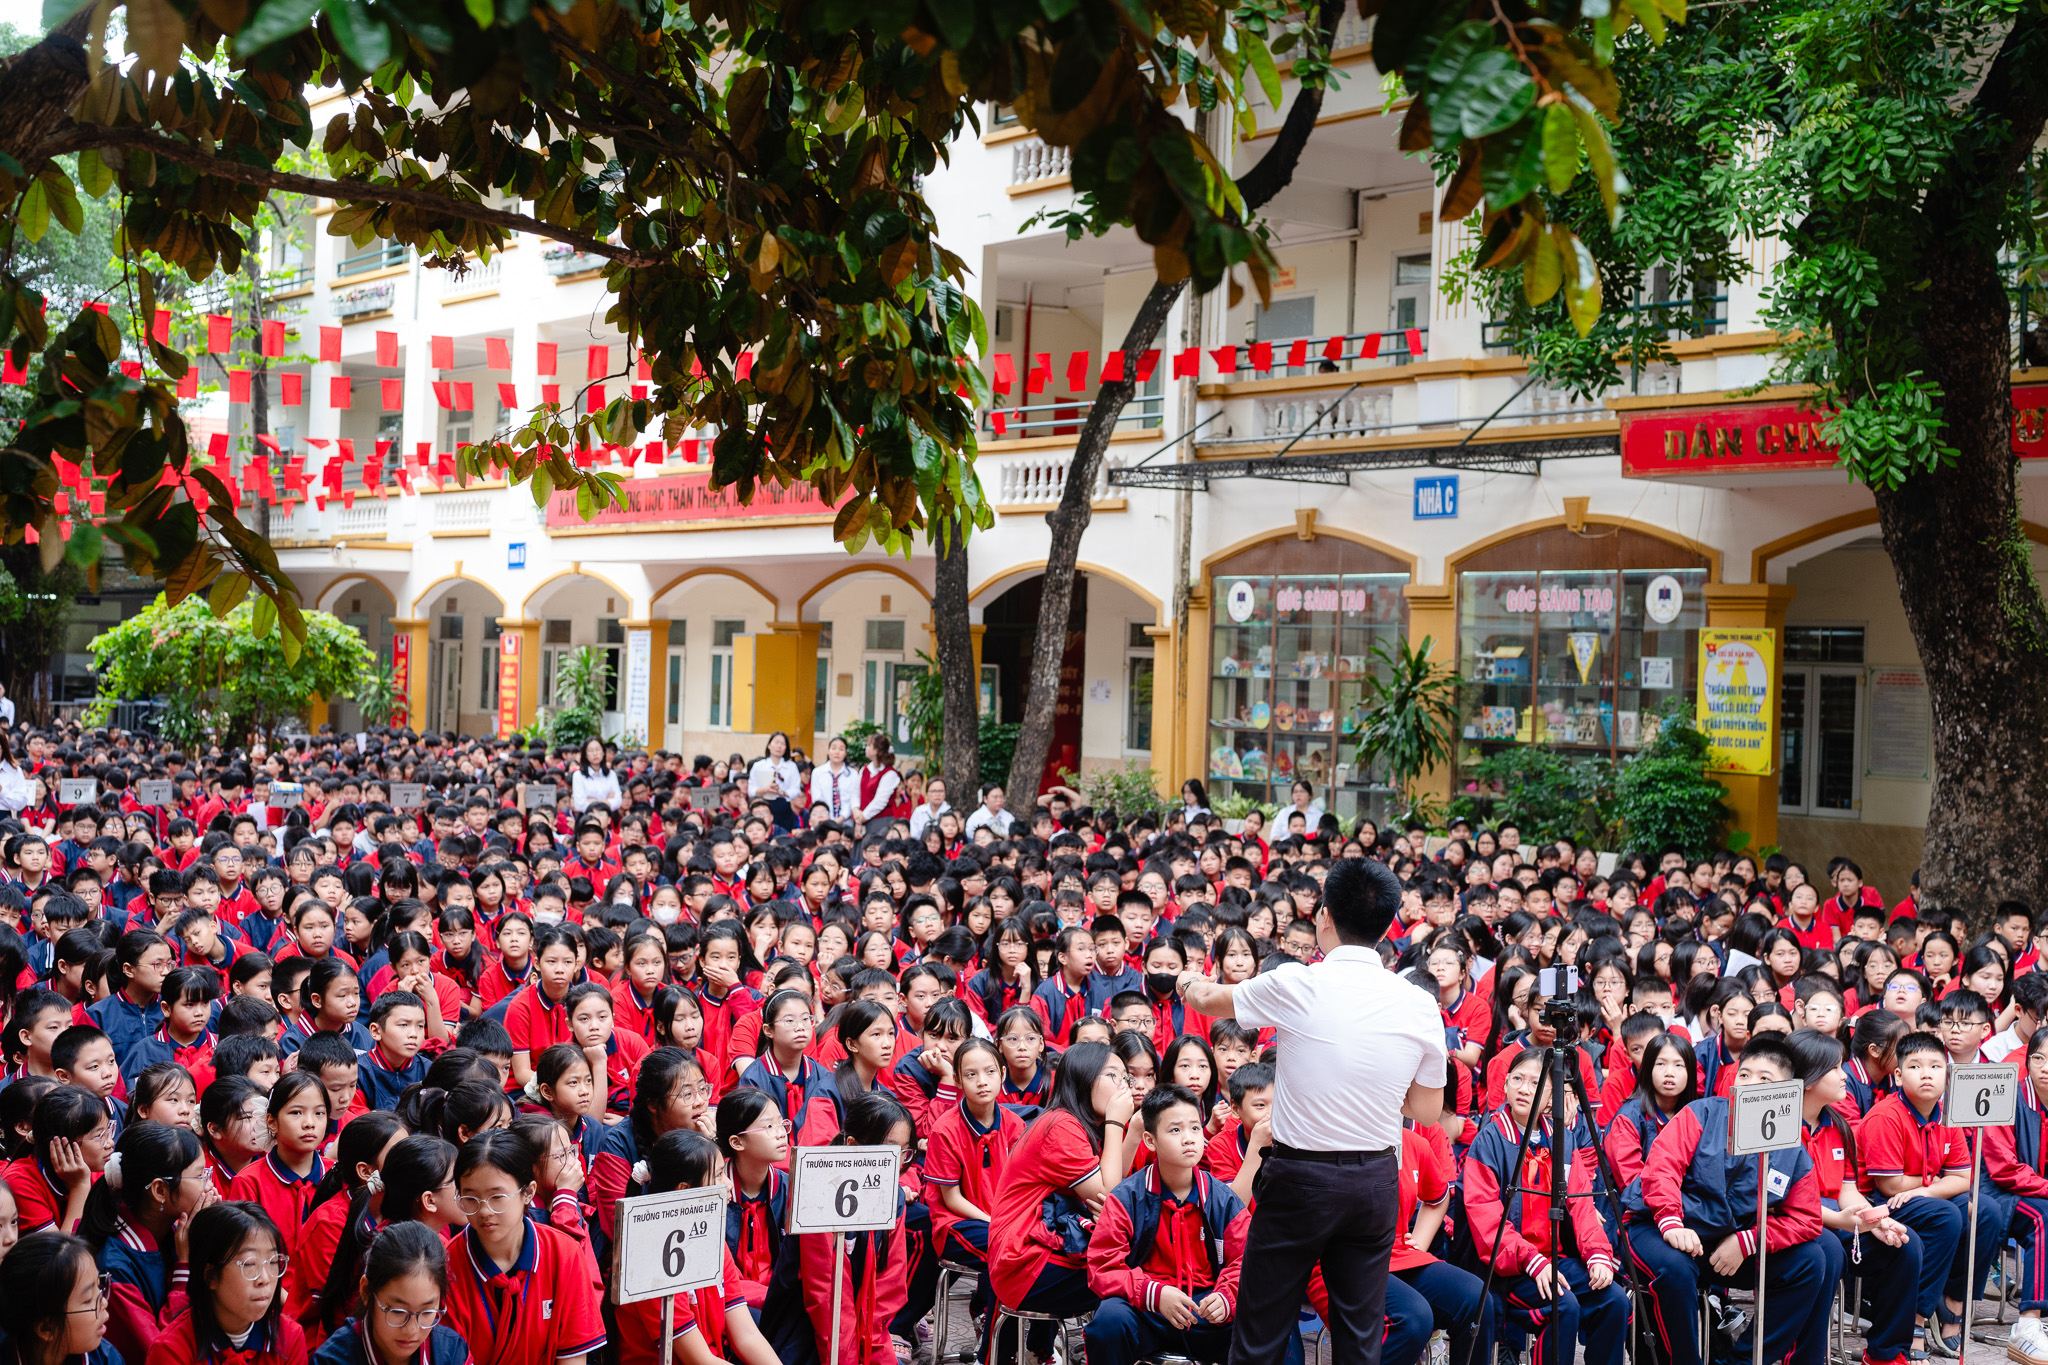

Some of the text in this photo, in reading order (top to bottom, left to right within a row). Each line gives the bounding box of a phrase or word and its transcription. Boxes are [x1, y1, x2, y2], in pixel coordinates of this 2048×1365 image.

[1664, 423, 1743, 461] DÂN
[1418, 481, 1454, 515] NHÀ C
[1277, 586, 1366, 617] GÓC SÁNG TẠO
[1506, 585, 1613, 618] GÓC SÁNG TẠO
[1752, 685, 1766, 696] NAM
[74, 788, 82, 800] 9
[153, 790, 160, 801] 7
[282, 793, 289, 804] 7
[403, 793, 410, 803] 7
[538, 793, 544, 803] 7
[1975, 1084, 2005, 1117] 6 A5
[1761, 1104, 1791, 1141] 6 A6
[806, 1157, 891, 1168] TRƯỜNG THCS HOÀNG LIỆT
[835, 1174, 881, 1218] 6 A8
[633, 1202, 718, 1223] TRƯỜNG THCS HOÀNG LIỆT
[662, 1221, 707, 1277] 6 A9
